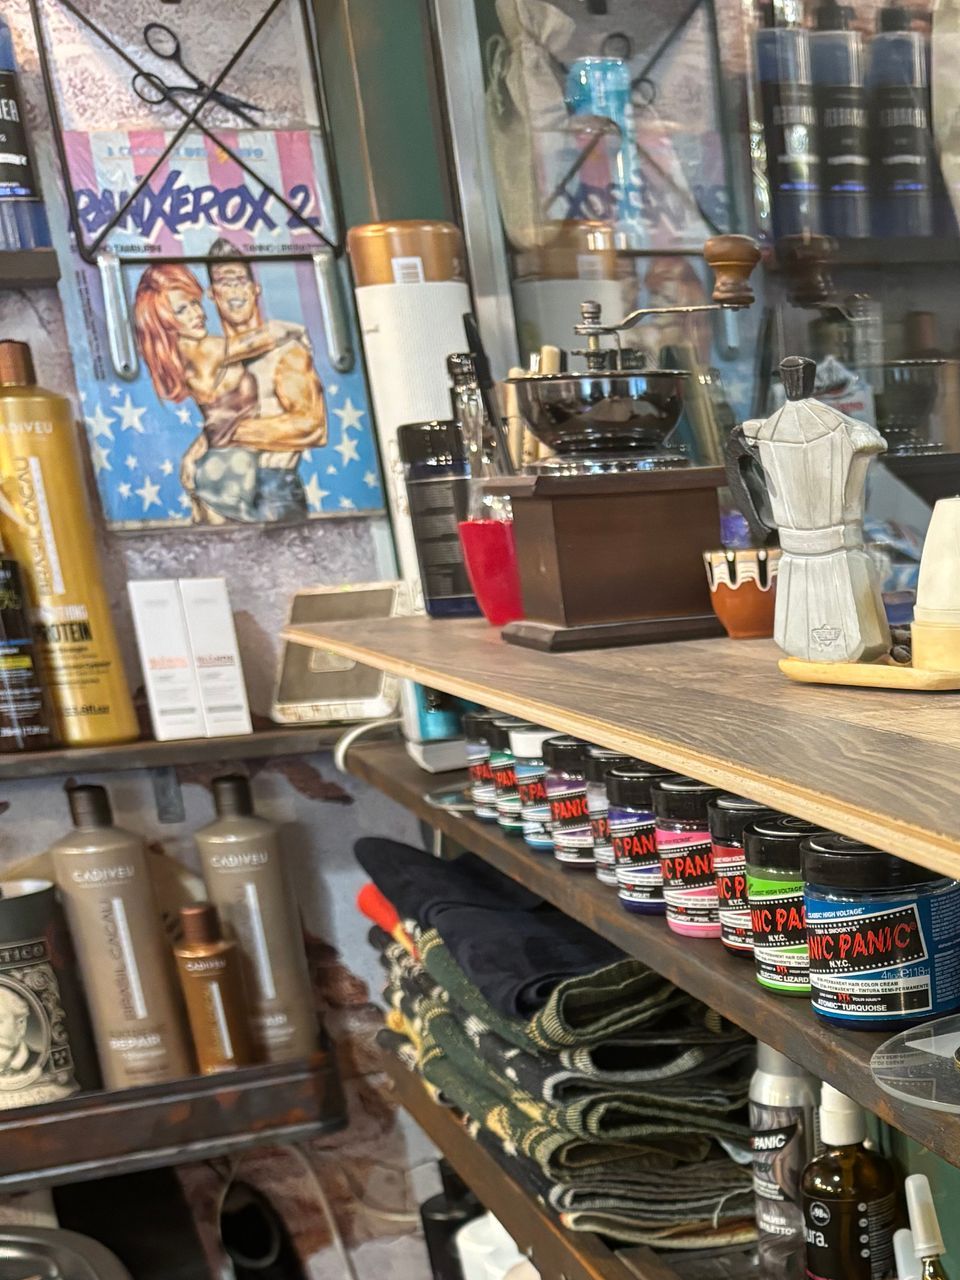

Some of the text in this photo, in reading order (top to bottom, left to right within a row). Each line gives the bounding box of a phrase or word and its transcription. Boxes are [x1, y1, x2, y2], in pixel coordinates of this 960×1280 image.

[287, 184, 321, 229] 2
[752, 908, 772, 933] NIC
[822, 910, 835, 918] HIGH
[808, 935, 835, 960] NIC
[829, 959, 851, 968] N.Y.C.
[783, 973, 809, 984] LIZARD
[841, 1002, 887, 1012] TURQUOISE
[754, 1134, 786, 1150] PANIC
